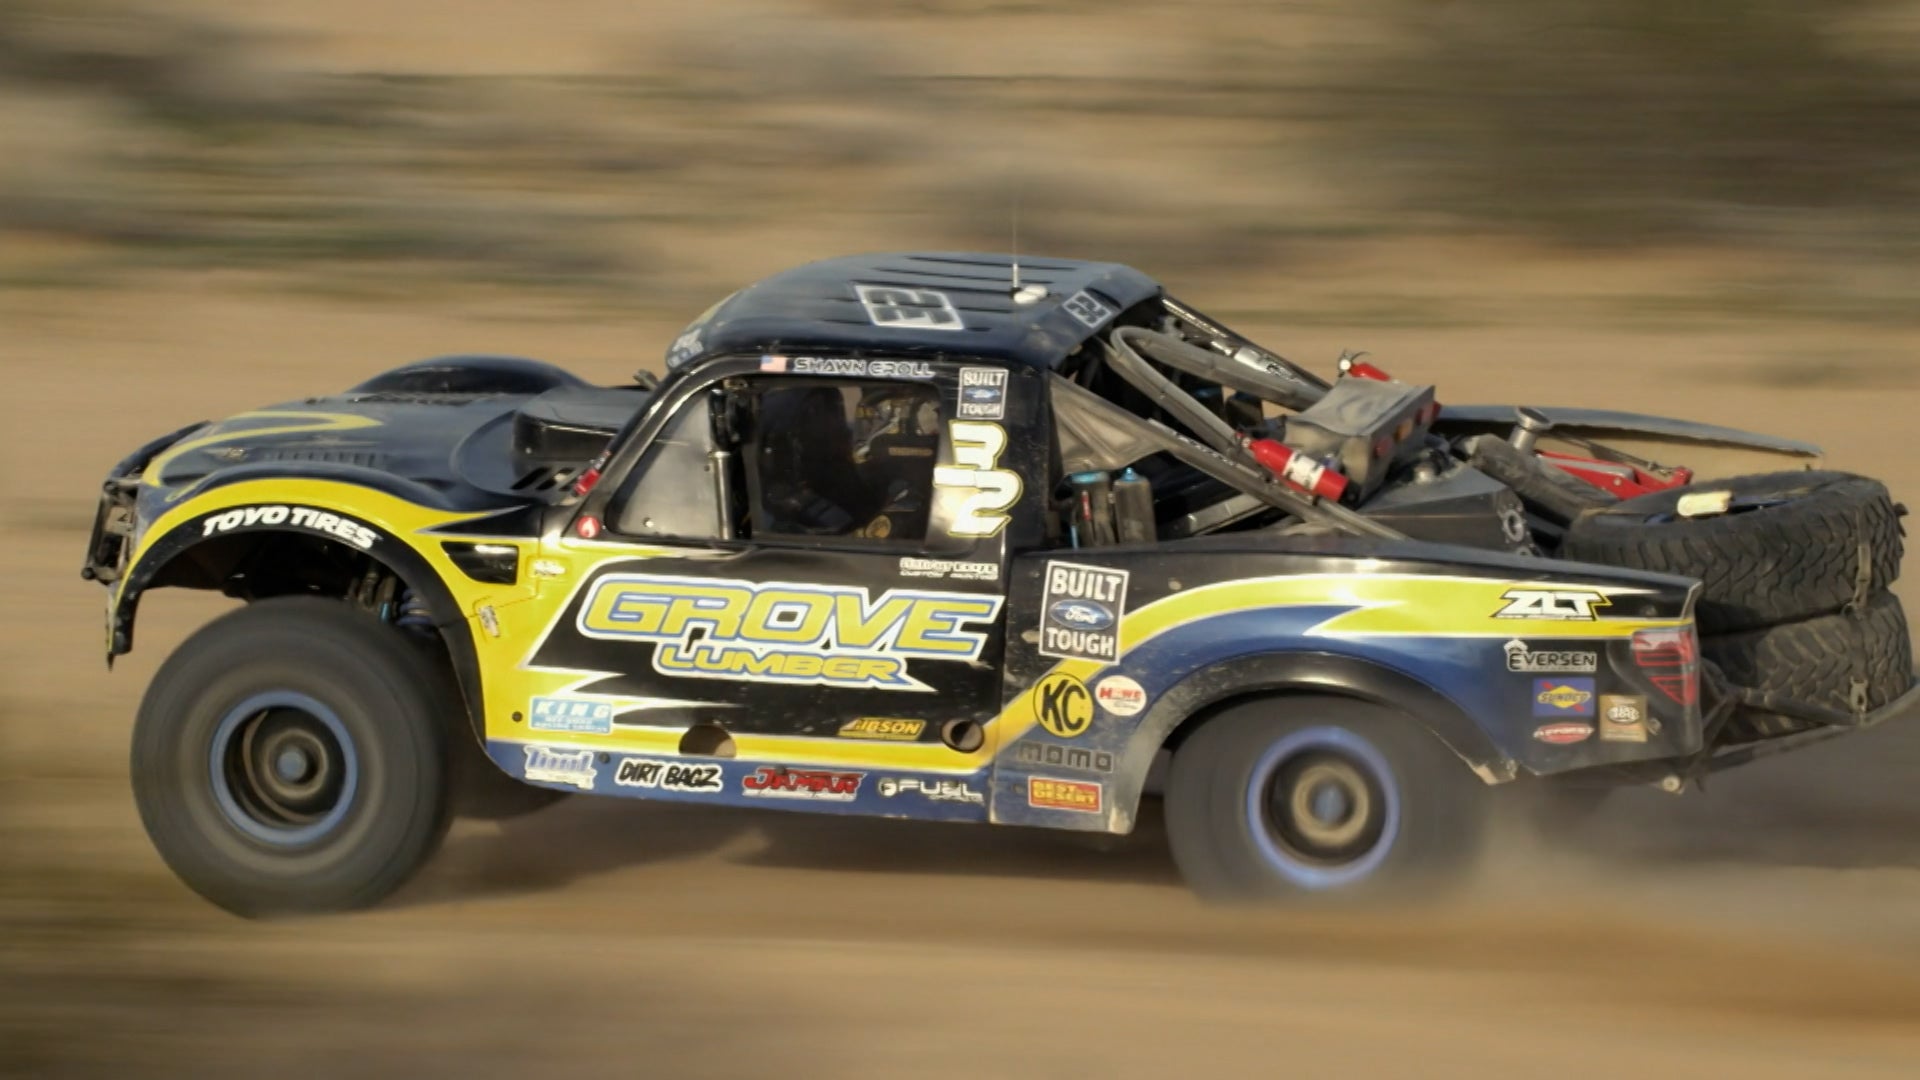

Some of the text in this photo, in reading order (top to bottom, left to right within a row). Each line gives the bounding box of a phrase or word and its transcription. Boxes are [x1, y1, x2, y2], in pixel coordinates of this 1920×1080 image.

[794, 357, 936, 378] SHAWN CROLL
[963, 371, 1004, 386] BUILT
[961, 403, 1001, 416] TOUGH
[933, 420, 1023, 538] 32
[202, 505, 377, 549] TOYO TIRES
[1050, 567, 1122, 602] BUILT
[581, 578, 996, 654] GROVE
[1046, 627, 1115, 657] TOUGH
[658, 643, 908, 683] LUMBER
[1509, 651, 1595, 670] EVERSEN
[534, 701, 611, 718] KING
[1041, 679, 1086, 732] KC
[618, 761, 663, 783] DIRT
[664, 765, 720, 788] BAGZ
